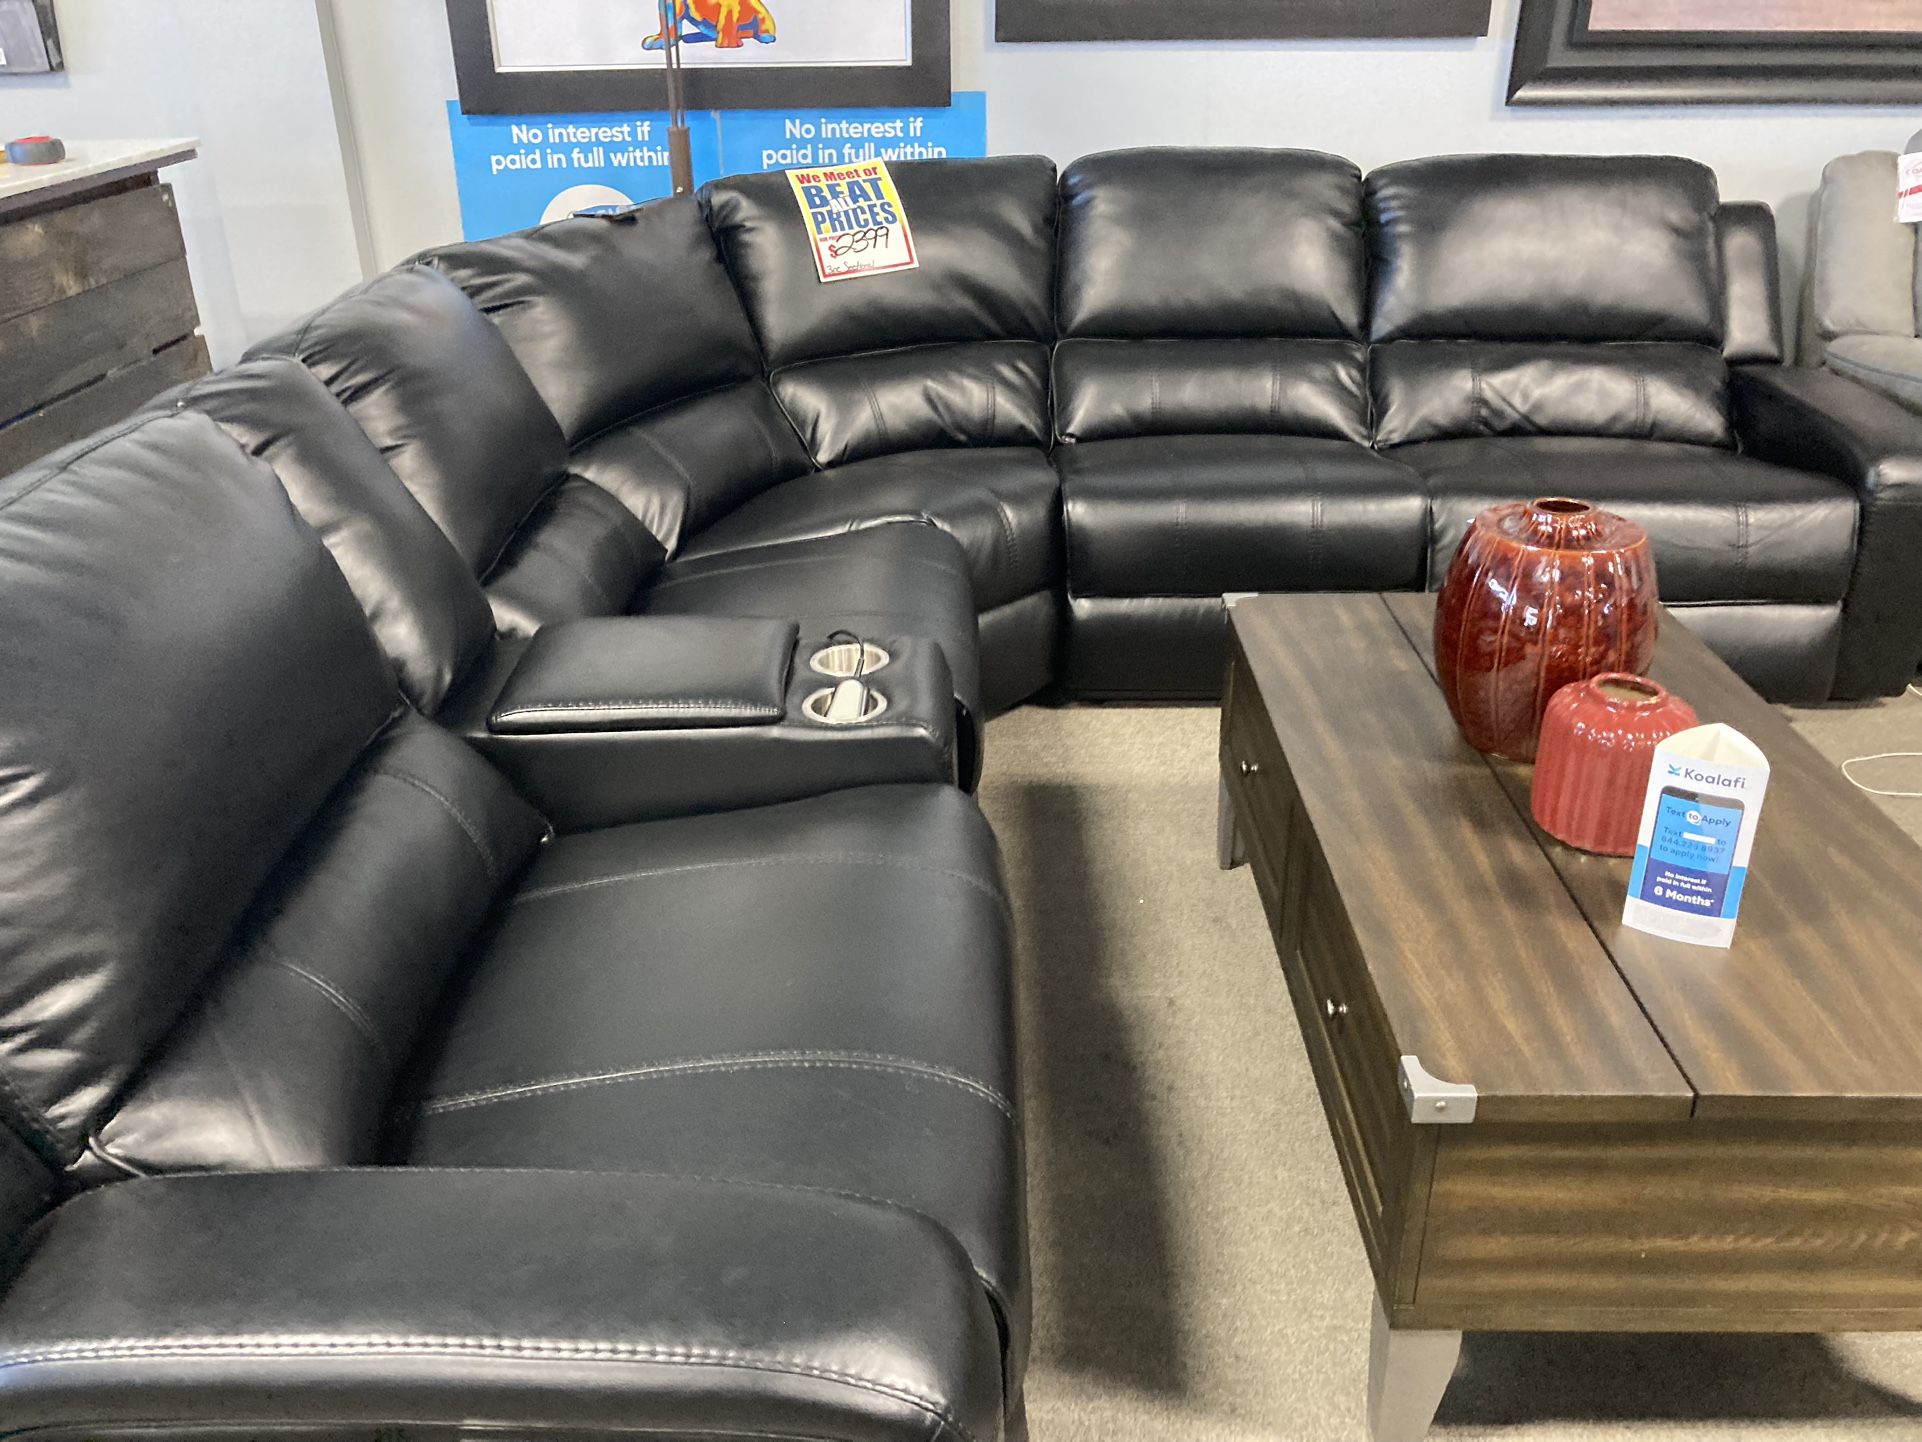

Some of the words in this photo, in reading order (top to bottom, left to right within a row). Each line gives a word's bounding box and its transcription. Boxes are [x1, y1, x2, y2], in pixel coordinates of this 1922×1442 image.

[511, 124, 543, 144] No
[548, 123, 632, 143] interest
[635, 121, 651, 142] if
[785, 118, 815, 139] No
[820, 118, 904, 138] interest
[908, 116, 924, 137] if
[490, 149, 542, 175] paid
[546, 149, 567, 169] in
[571, 146, 605, 168] full
[762, 143, 812, 169] paid
[818, 143, 838, 164] in
[842, 142, 875, 164] full
[880, 141, 947, 161] within
[795, 173, 821, 185] We
[822, 168, 859, 182] Meet
[860, 166, 879, 176] or
[801, 177, 885, 210] BEAT
[830, 196, 857, 214] ALL
[811, 201, 898, 235] PRICES
[1684, 767, 1746, 789] Koalafi
[1666, 806, 1686, 818] Text
[1688, 812, 1699, 821] to
[1701, 815, 1732, 828] Apply
[1659, 844, 1669, 852] to
[1670, 848, 1695, 860] apply
[1717, 838, 1727, 846] to
[1656, 876, 1672, 885] paid
[1680, 881, 1691, 889] full
[1691, 884, 1713, 893] within
[1664, 870, 1675, 878] No
[1675, 873, 1700, 884] interest
